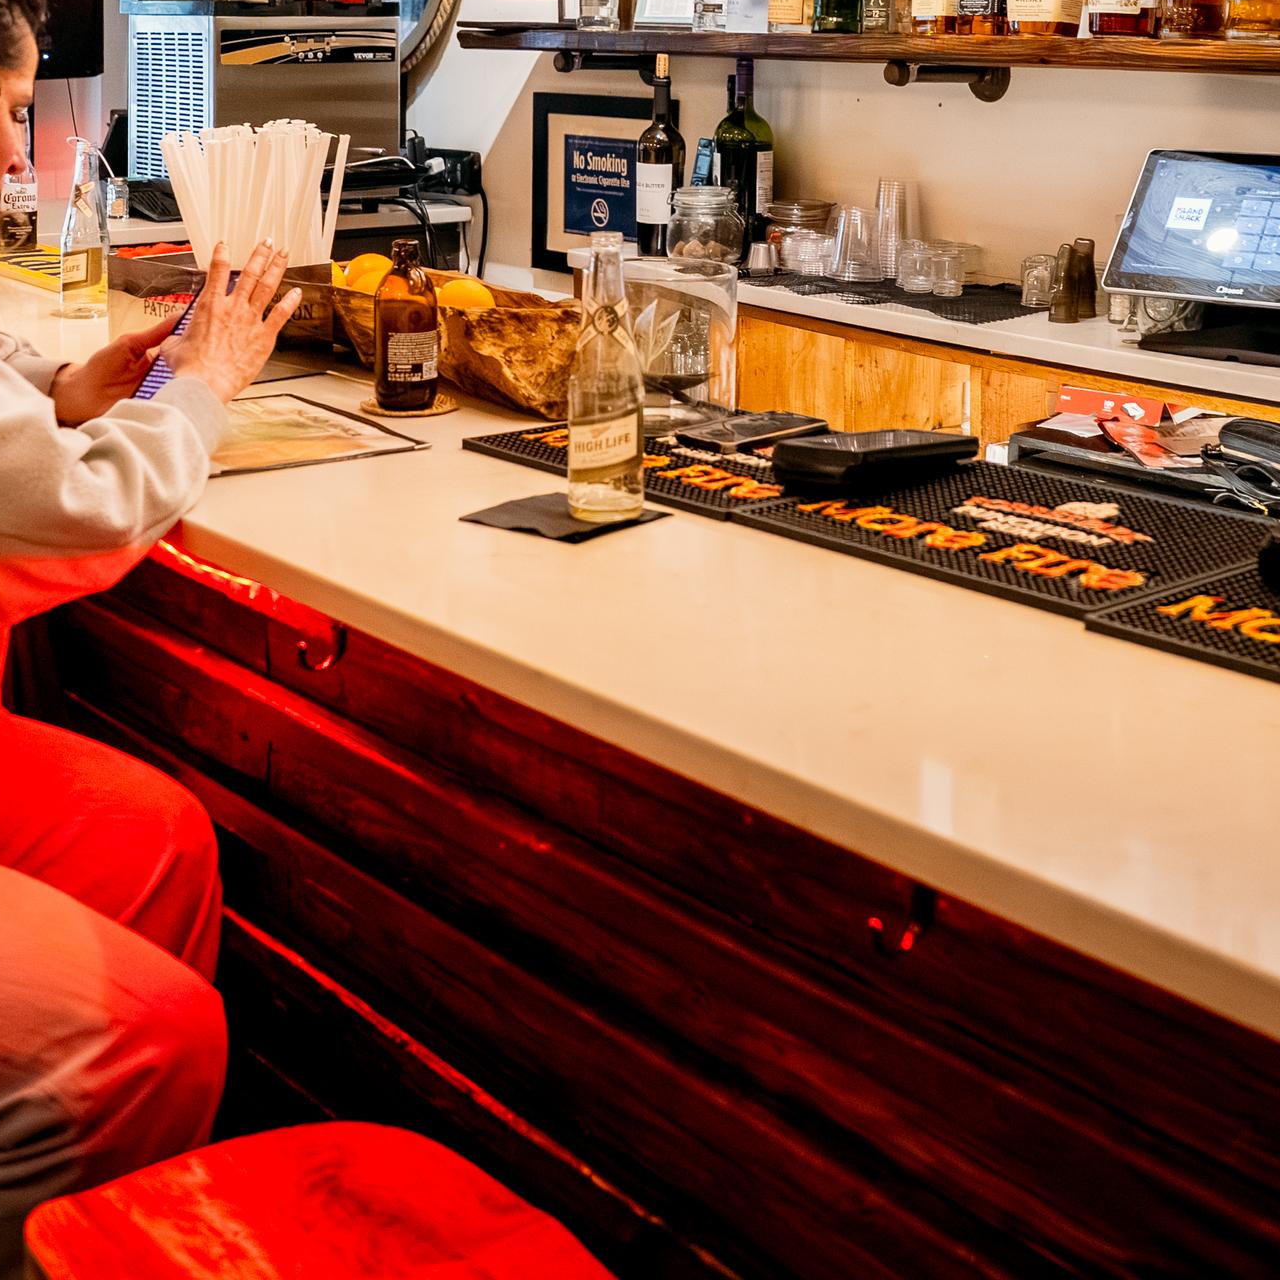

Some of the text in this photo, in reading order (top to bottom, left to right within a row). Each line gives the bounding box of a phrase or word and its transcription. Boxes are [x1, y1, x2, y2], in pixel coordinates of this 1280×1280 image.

[573, 151, 627, 176] No Smoking
[3, 193, 36, 205] Corona
[65, 264, 81, 273] LIFE
[574, 432, 631, 454] HIGH LIFE
